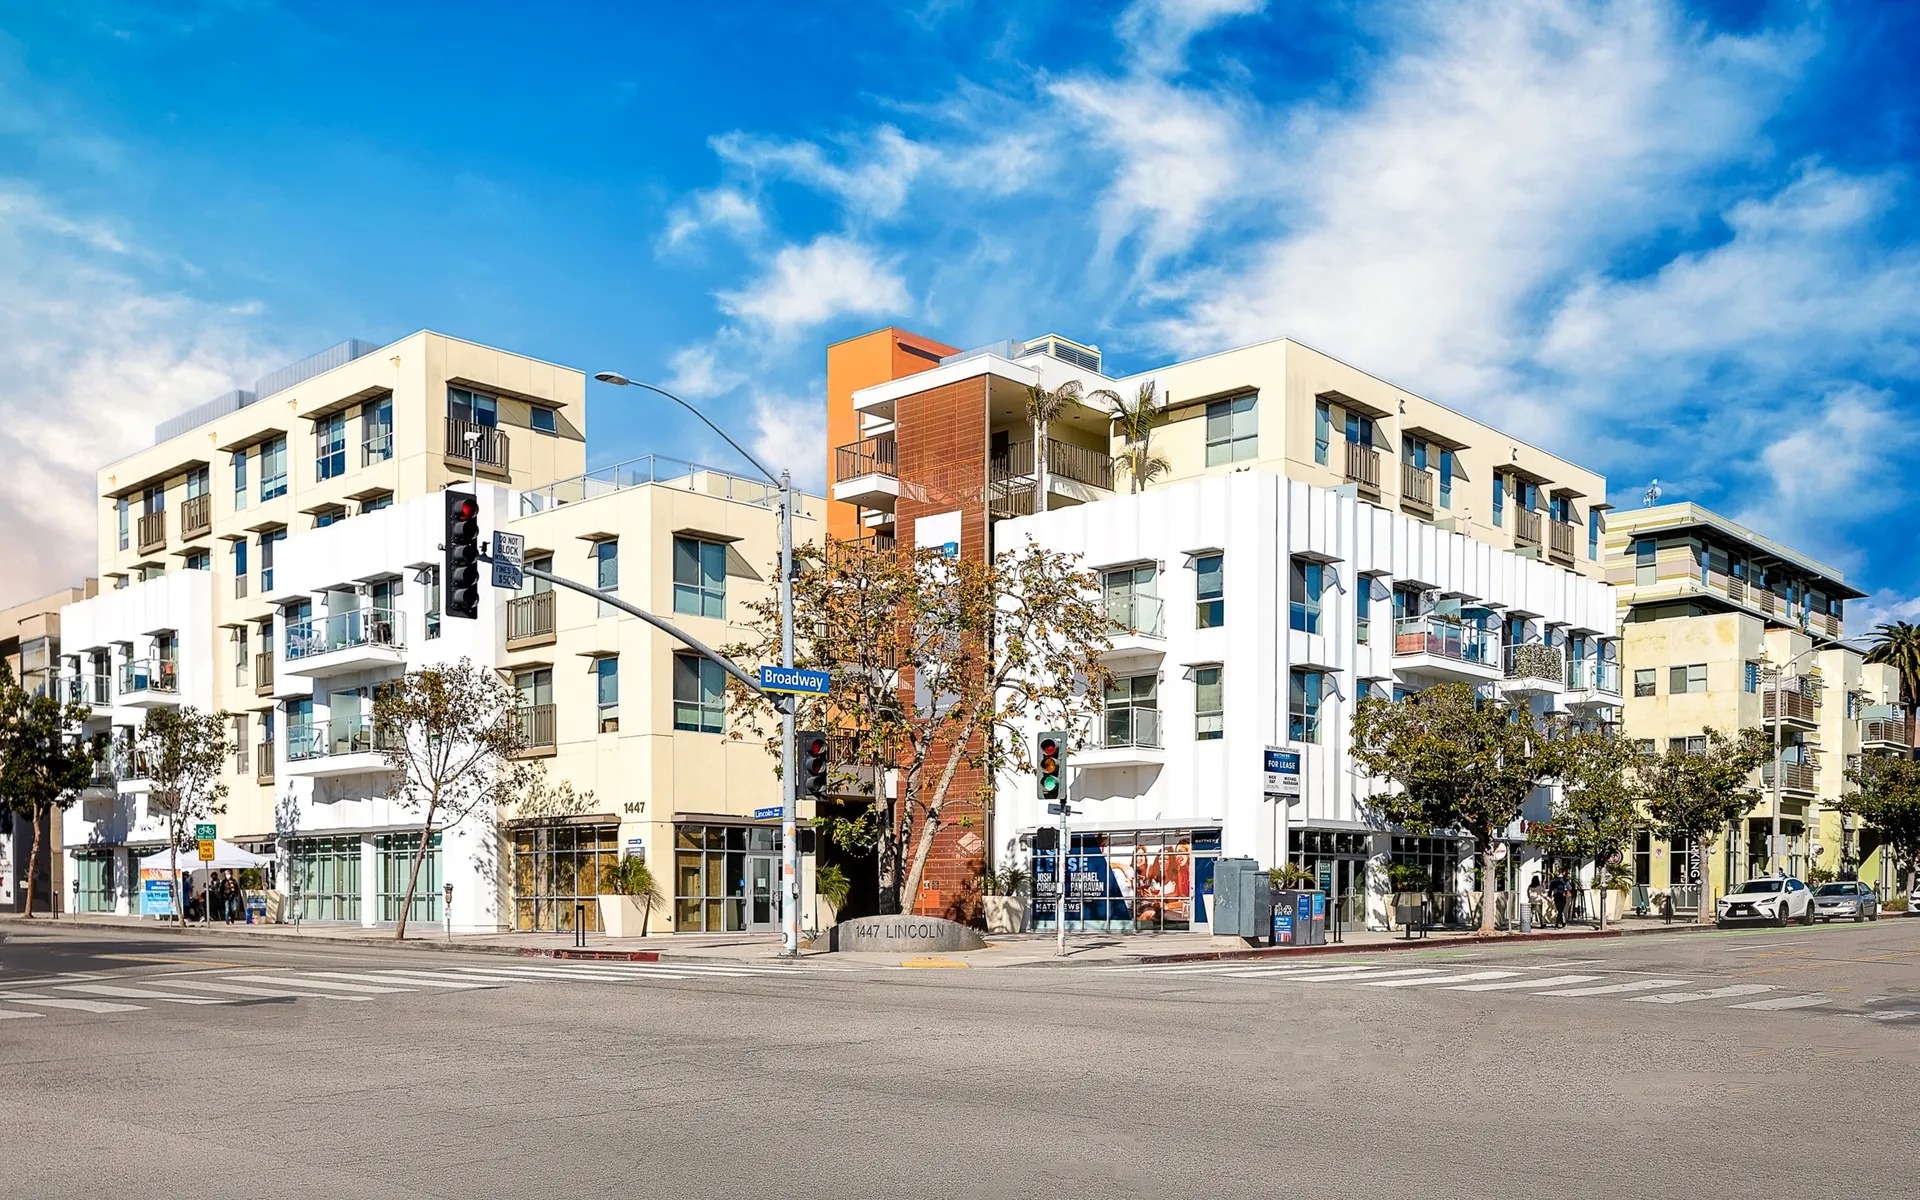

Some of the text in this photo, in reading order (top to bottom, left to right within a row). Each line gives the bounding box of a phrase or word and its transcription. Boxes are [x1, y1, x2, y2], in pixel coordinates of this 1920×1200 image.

[499, 535, 519, 546] DO NOT
[497, 544, 519, 556] BLOCK
[495, 564, 520, 576] FINES TO
[498, 574, 516, 585] $500
[765, 669, 824, 692] Broadway
[1268, 759, 1296, 770] FOR LEASE
[624, 802, 645, 814] 1447
[755, 809, 774, 818] Lincoln
[1036, 857, 1089, 872] LESE
[1690, 839, 1700, 878] ARKING
[1036, 872, 1052, 883] JOSH
[855, 924, 945, 939] 1447 LINCOLN
